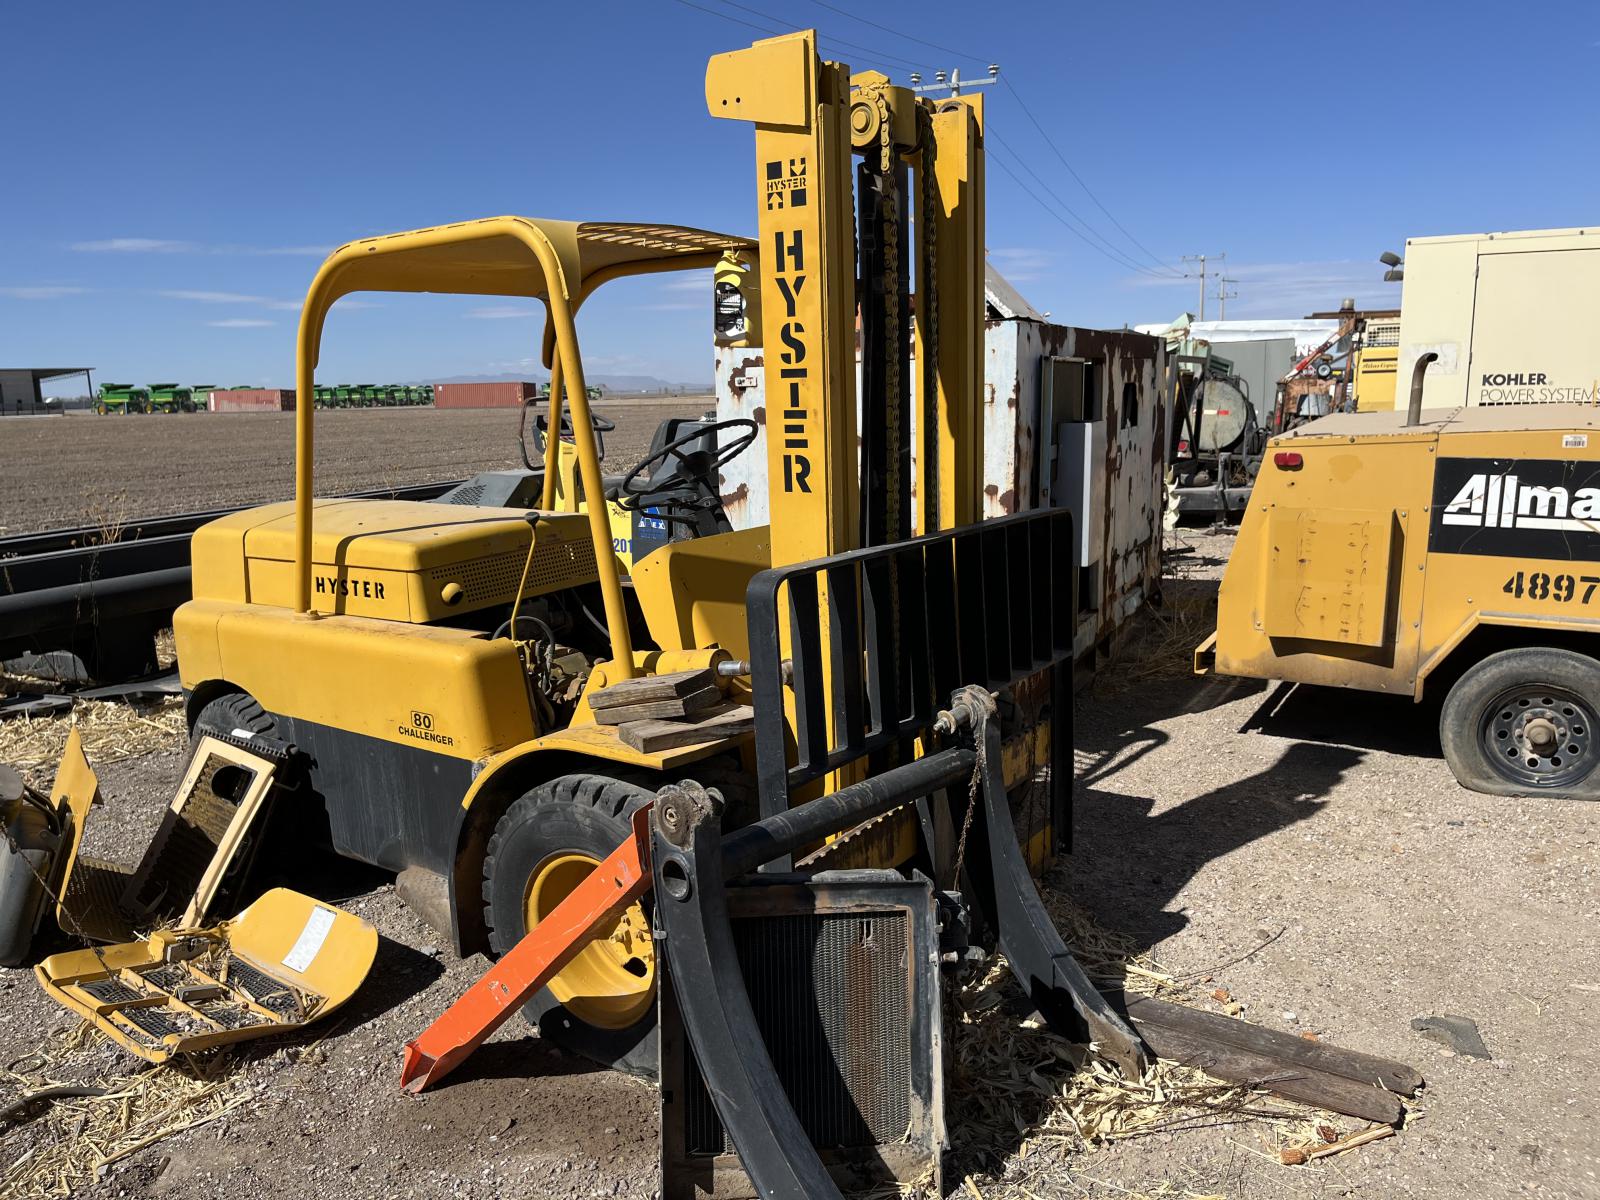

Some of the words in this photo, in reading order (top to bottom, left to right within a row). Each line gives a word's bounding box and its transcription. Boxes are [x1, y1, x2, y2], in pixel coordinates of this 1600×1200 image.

[767, 177, 807, 192] HYSTER
[775, 230, 812, 493] HYSTER
[1482, 373, 1547, 386] KOHLER
[1480, 388, 1535, 402] POWER
[316, 576, 385, 600] HYSTER
[1503, 571, 1600, 604] 4897
[414, 713, 431, 729] 80
[398, 726, 454, 746] CHALLENGER
